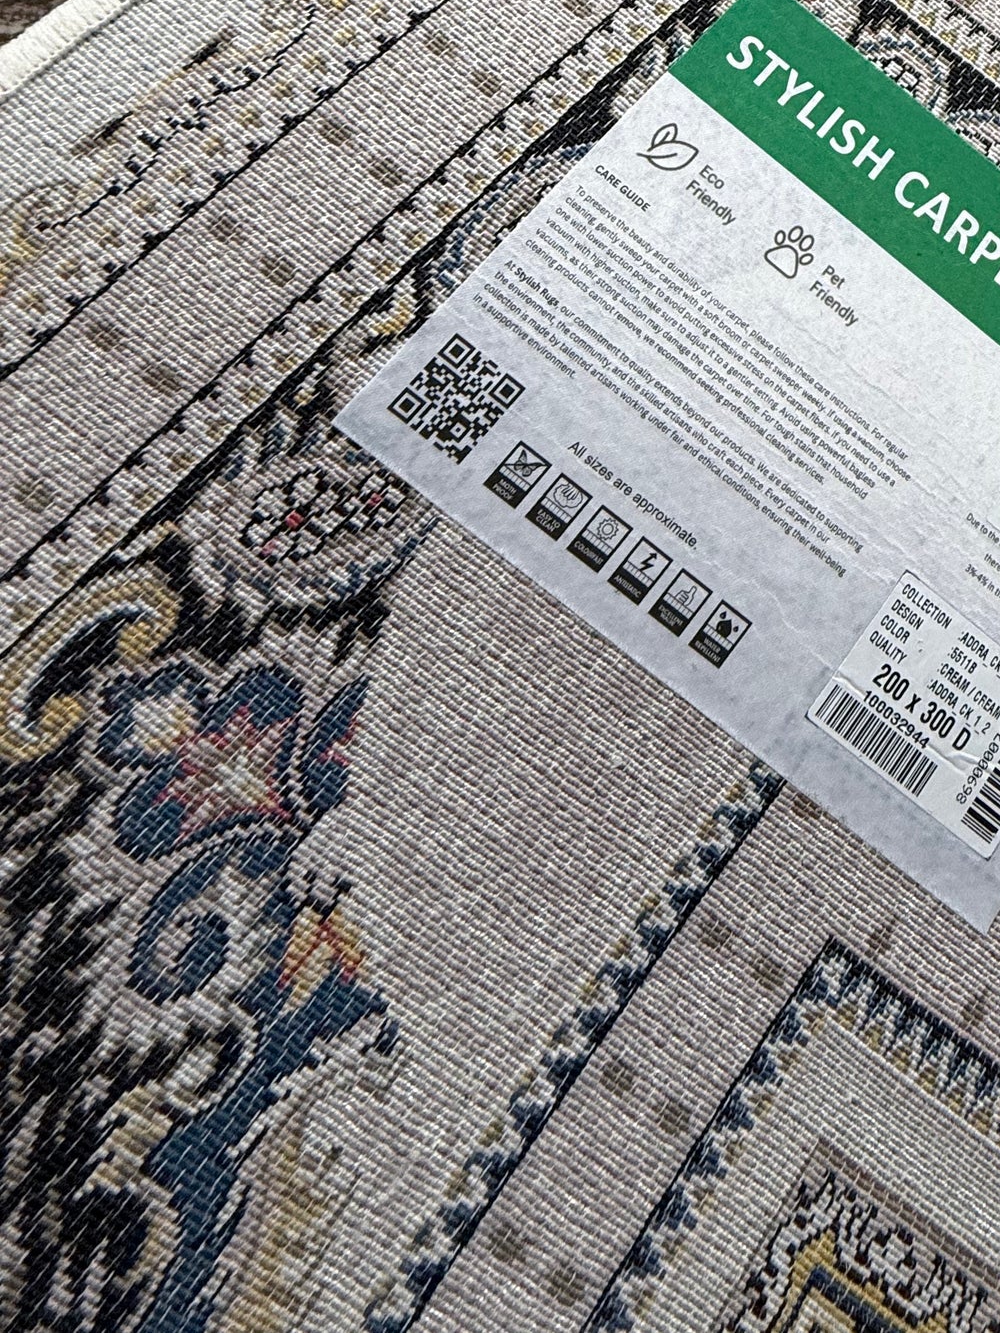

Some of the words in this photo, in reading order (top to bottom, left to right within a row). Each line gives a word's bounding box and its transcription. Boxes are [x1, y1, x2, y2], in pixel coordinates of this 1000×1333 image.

[725, 35, 896, 181] STYLISH
[594, 164, 622, 189] CARE
[618, 184, 651, 213] GUIDE
[698, 163, 725, 190] Eco
[684, 178, 737, 226] Friendly
[820, 264, 846, 290] Pet
[575, 184, 586, 198] To
[582, 194, 618, 223] preserve
[615, 218, 630, 233] the
[627, 227, 655, 254] beauty
[651, 249, 670, 265] and
[666, 261, 702, 293] durability
[699, 288, 713, 299] of
[706, 295, 728, 312] your
[724, 308, 750, 335] carpet,
[747, 328, 774, 351] please
[772, 345, 796, 369] follow
[793, 364, 815, 385] these
[812, 381, 831, 398] care
[828, 392, 871, 432] instructions.
[870, 426, 885, 441] For
[881, 437, 909, 461] regular
[808, 279, 859, 328] Friendly
[471, 292, 483, 304] in
[479, 300, 489, 312] a
[484, 304, 530, 341] supportive
[526, 336, 576, 380] environment.
[564, 196, 598, 227] cleaning,
[593, 222, 621, 244] gently
[617, 240, 643, 262] sweep
[638, 258, 661, 275] your
[658, 272, 684, 295] carpet
[681, 291, 699, 308] with
[696, 304, 705, 313] a
[702, 308, 720, 324] soft
[716, 318, 743, 344] broom
[740, 339, 752, 350] or
[748, 346, 775, 370] carpet
[771, 365, 803, 392] sweeper
[800, 389, 827, 414] weekly.
[825, 408, 836, 418] If
[832, 414, 853, 436] using
[850, 430, 858, 439] a
[856, 434, 885, 463] vacuum,
[884, 457, 912, 482] choose
[524, 238, 558, 269] cleaning
[552, 263, 590, 293] products
[587, 289, 616, 315] cannot
[612, 310, 643, 339] remove,
[642, 333, 656, 347] we
[653, 342, 699, 381] recommend
[695, 376, 725, 404] seeking
[720, 398, 769, 438] professional
[764, 432, 797, 463] cleaning
[793, 456, 825, 486] services.
[482, 282, 522, 316] collection
[518, 309, 530, 322] is
[526, 317, 551, 339] made
[547, 332, 561, 348] by
[558, 341, 594, 372] talented
[589, 367, 621, 395] artisans
[618, 390, 650, 420] working
[646, 413, 672, 435] under
[668, 429, 685, 445] fair
[681, 442, 701, 458] and
[696, 453, 726, 478] ethical
[721, 473, 761, 511] conditions,
[760, 504, 794, 536] ensuring
[790, 528, 811, 547] their
[808, 542, 847, 579] well-being
[503, 259, 517, 272] At
[513, 266, 542, 293] Stylish
[538, 286, 560, 310] Rugs,
[559, 305, 576, 319] our
[572, 315, 622, 357] commitment
[618, 351, 630, 364] to
[627, 359, 656, 385] quality
[652, 380, 684, 407] extends
[681, 401, 713, 429] beyond
[708, 425, 725, 439] our
[720, 435, 756, 467] products.
[756, 460, 770, 477] We
[767, 472, 782, 487] are
[779, 482, 818, 515] dedicated
[814, 509, 826, 522] to
[823, 517, 864, 554] supporting
[491, 482, 513, 501] PROOF
[498, 478, 517, 495] MOTH
[566, 440, 588, 459] All
[583, 454, 614, 482] sizes
[612, 477, 633, 497] are
[631, 492, 697, 551] approximate.
[535, 514, 556, 533] CLEAN
[536, 508, 553, 523] EASY
[550, 518, 561, 529] TO
[965, 511, 981, 530] Due
[978, 523, 989, 535] to
[986, 529, 1000, 544] the
[964, 562, 989, 587] 3%-4%
[986, 580, 995, 593] in
[879, 613, 911, 645] COLOR
[890, 598, 925, 631] DESIGN
[901, 582, 953, 630] COLLECTION
[703, 636, 721, 654] WATER
[868, 629, 908, 665] QUALITY
[925, 678, 992, 735] :ADORA_CK_1_2
[862, 689, 930, 750] 100032944
[871, 662, 910, 702] 200
[903, 692, 922, 714] x
[919, 700, 956, 739] 300
[951, 726, 972, 751] D
